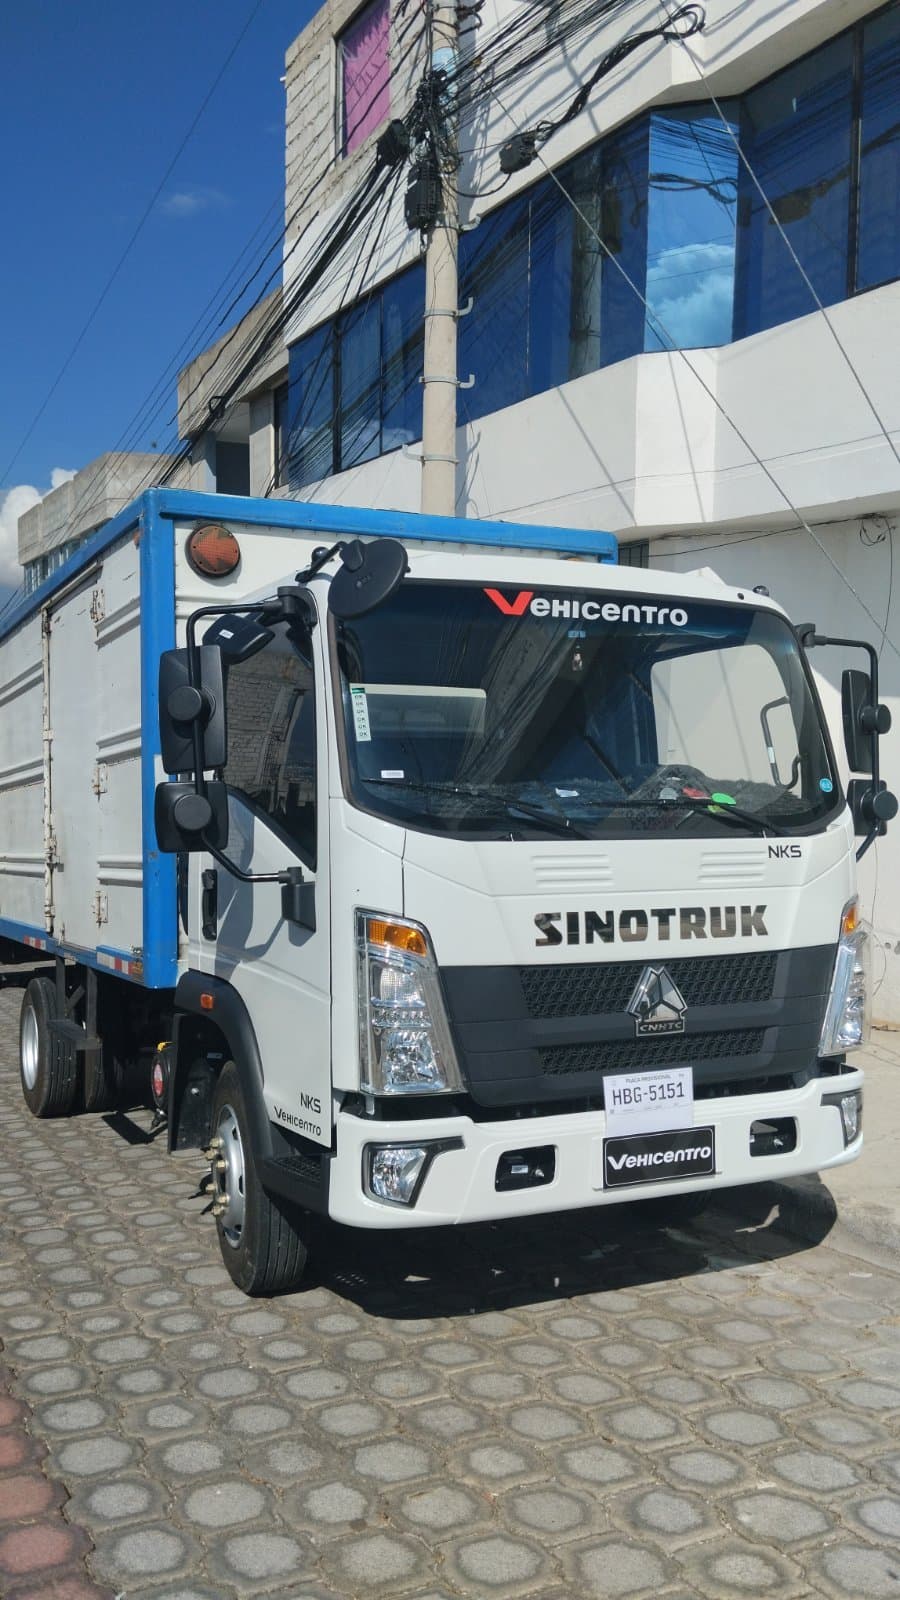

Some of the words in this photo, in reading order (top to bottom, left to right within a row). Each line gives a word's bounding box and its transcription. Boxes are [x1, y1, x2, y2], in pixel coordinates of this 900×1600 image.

[768, 845, 802, 859] NKS
[534, 905, 768, 947] SINOTRUK
[639, 1021, 682, 1032] CNHTC
[300, 1092, 321, 1114] NKS
[612, 1082, 685, 1106] HBG-5151
